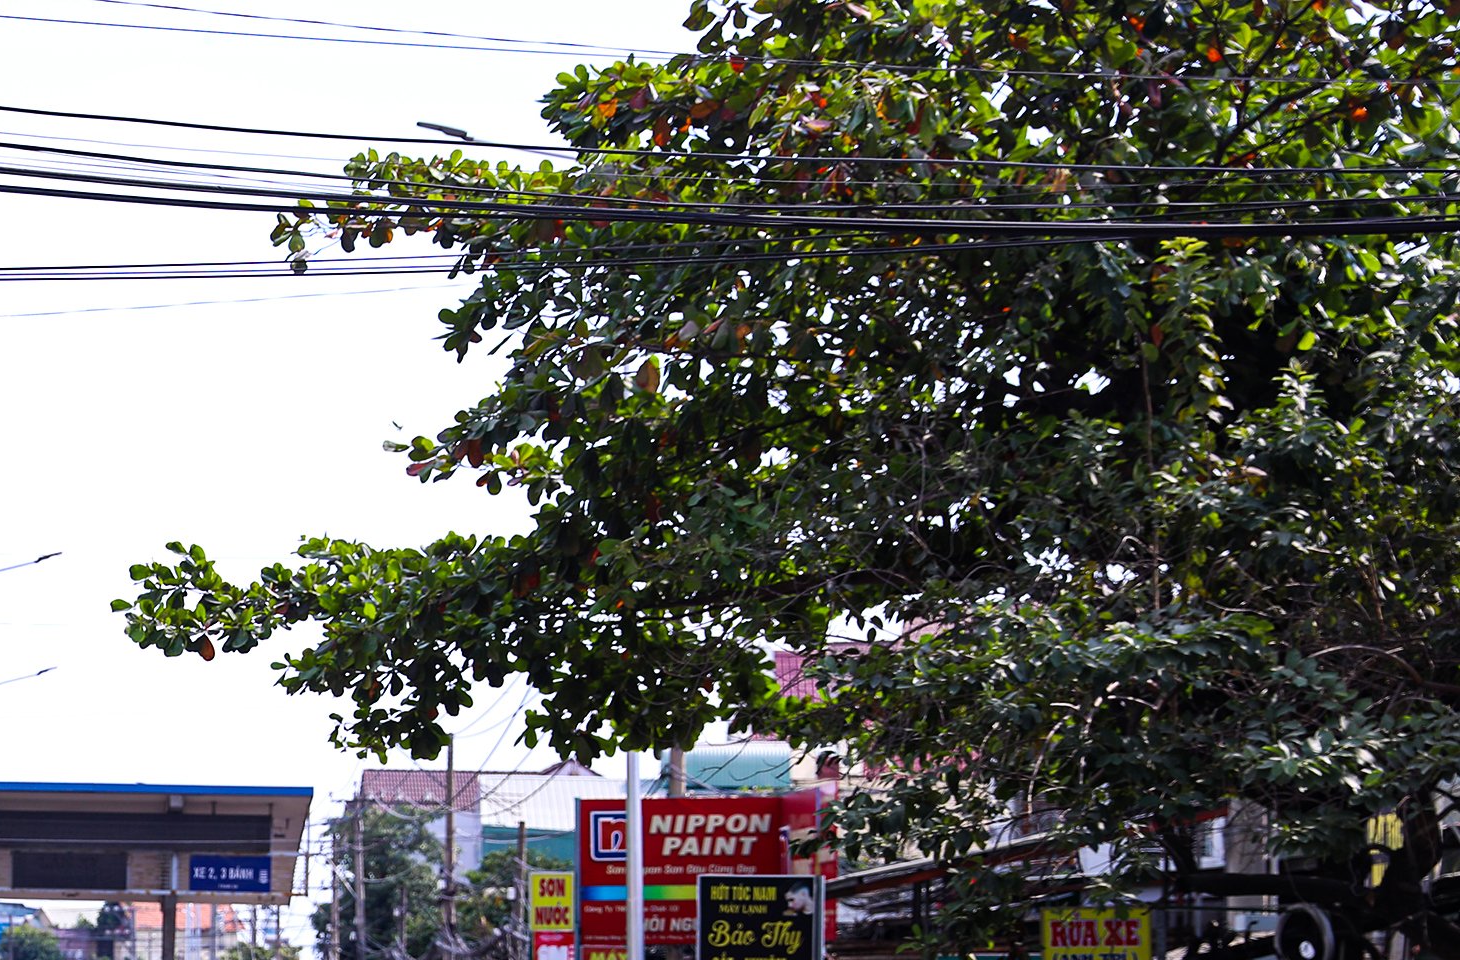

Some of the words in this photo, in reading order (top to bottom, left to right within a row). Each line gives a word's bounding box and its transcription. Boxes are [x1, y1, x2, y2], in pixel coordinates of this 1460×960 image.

[649, 813, 772, 834] NIPPON
[661, 836, 758, 857] PAINT
[761, 921, 802, 955] Thy
[1104, 920, 1140, 947] XE
